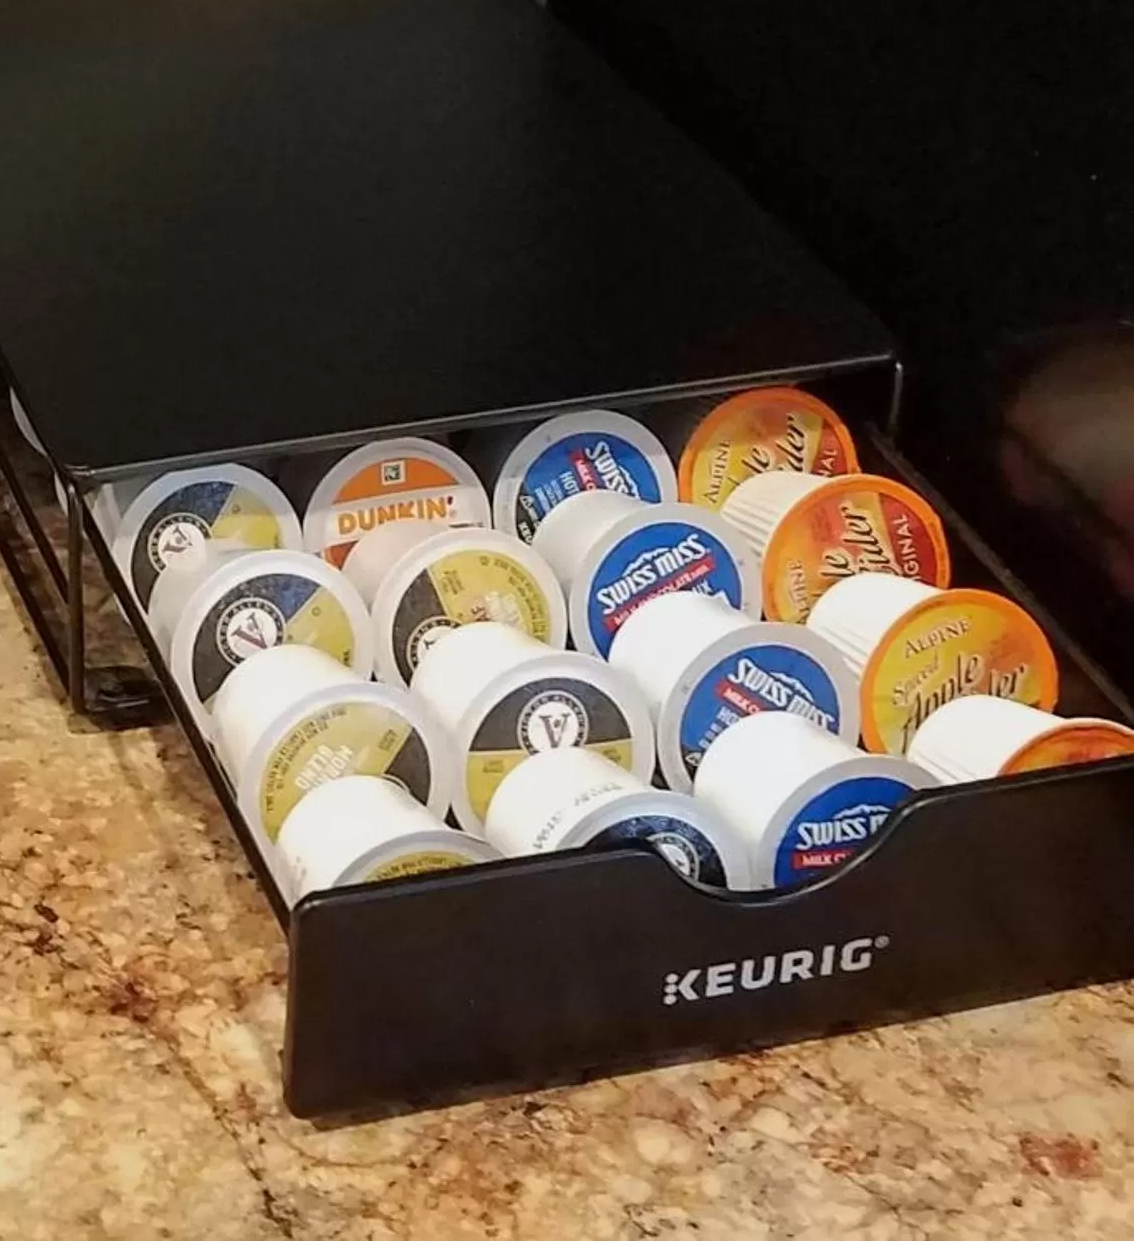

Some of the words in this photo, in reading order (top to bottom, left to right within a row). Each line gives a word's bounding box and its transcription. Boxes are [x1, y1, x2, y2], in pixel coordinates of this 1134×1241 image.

[703, 439, 732, 503] ALPINE
[337, 495, 454, 535] DUNKIN'
[596, 564, 658, 615] SWISS
[904, 615, 972, 659] ALPINE
[727, 658, 793, 708] SWISS
[795, 816, 867, 851] SWISS
[663, 937, 874, 1006] KEURIG
